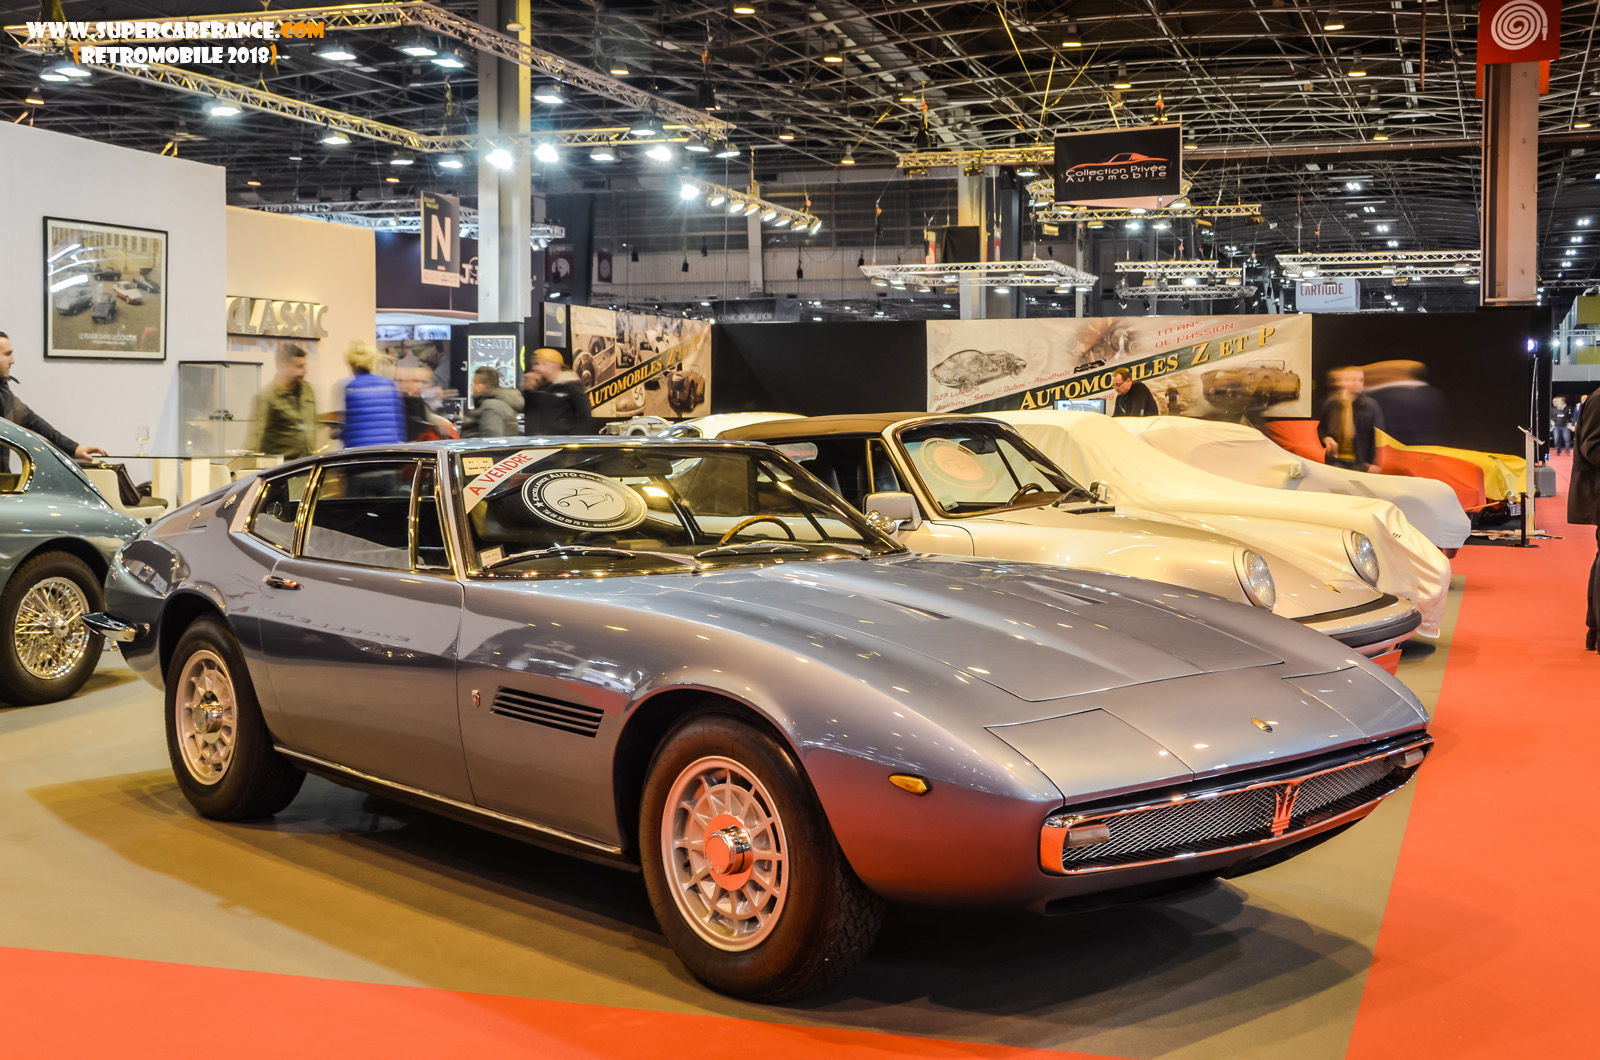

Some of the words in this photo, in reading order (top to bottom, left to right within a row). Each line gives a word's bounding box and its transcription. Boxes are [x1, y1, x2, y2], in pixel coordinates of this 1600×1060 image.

[1065, 167, 1127, 178] Collection
[1130, 164, 1167, 173] Privée
[1065, 170, 1168, 183] Automobile
[431, 214, 452, 262] N
[227, 297, 329, 338] CLASSIC
[1157, 327, 1173, 337] 10
[1177, 321, 1204, 332] ANS
[1155, 340, 1171, 348] DE
[1177, 323, 1234, 343] PASSION
[588, 357, 663, 408] AUTOMOBILES
[694, 335, 701, 353] P
[1020, 353, 1180, 410] AUTOMOILES
[1191, 342, 1210, 366] Z
[1219, 335, 1250, 358] ET
[1258, 325, 1276, 348] P
[935, 400, 966, 412] Bombay
[974, 390, 996, 401] Seoul
[1003, 383, 1026, 393] Dubai
[469, 486, 487, 496] A
[478, 453, 533, 483] VENDRE
